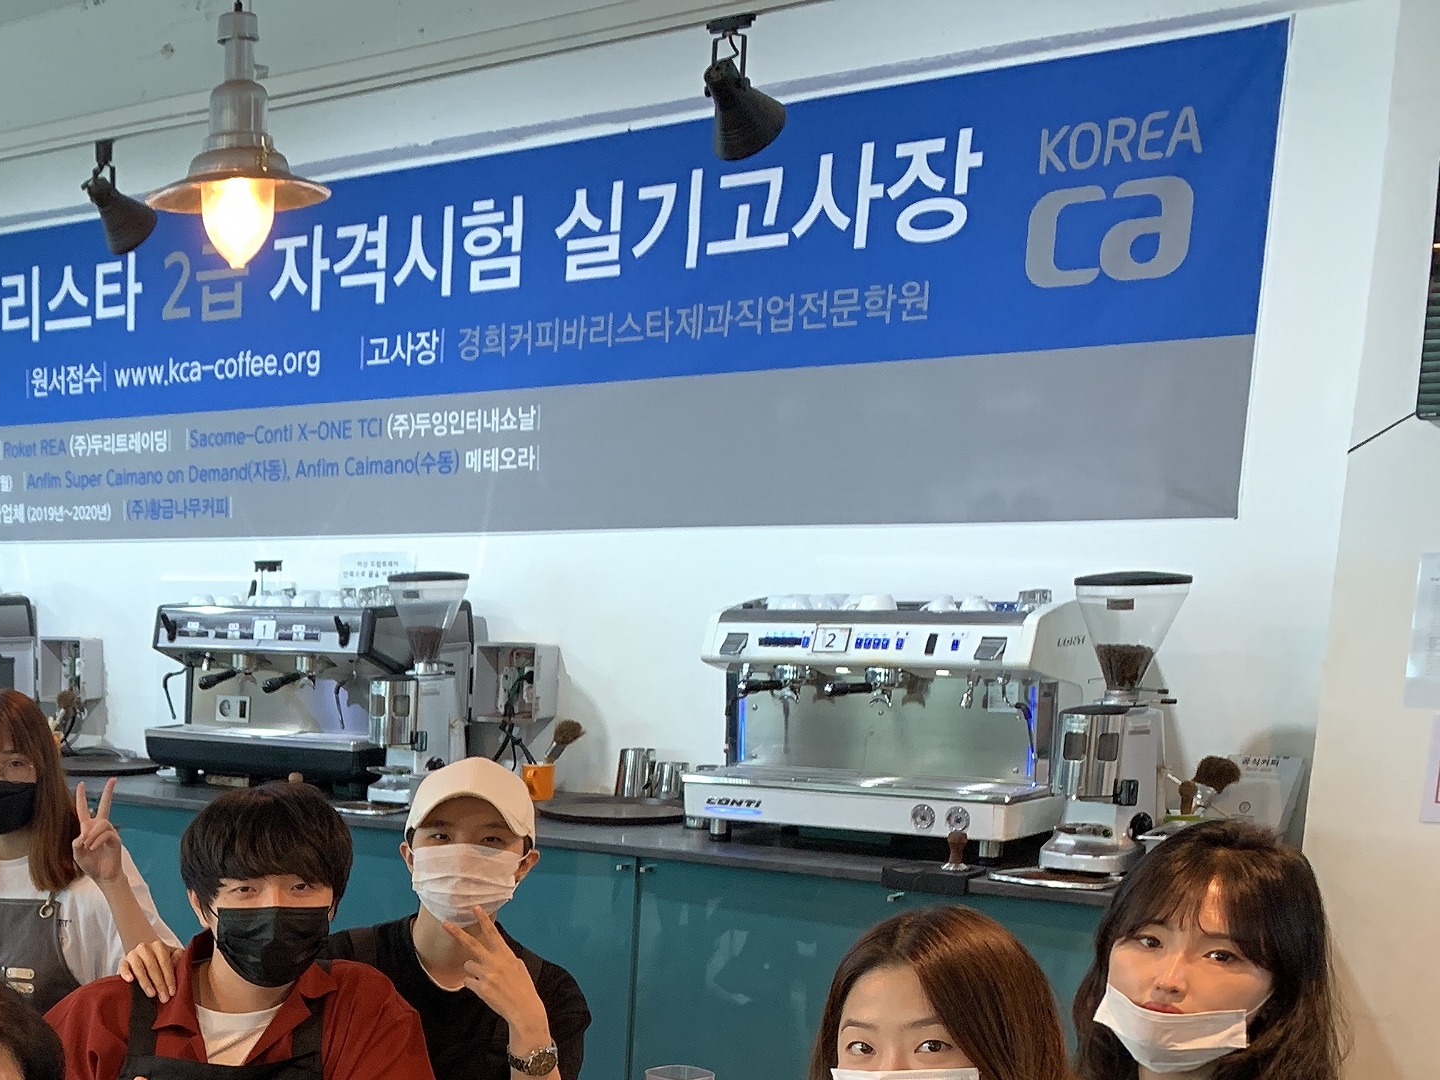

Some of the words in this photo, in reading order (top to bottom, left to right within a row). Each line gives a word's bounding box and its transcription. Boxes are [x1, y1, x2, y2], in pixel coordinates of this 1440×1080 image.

[1040, 106, 1202, 175] KOREA
[270, 196, 524, 311] 자격시험
[555, 128, 984, 283] 실기고사장
[1025, 176, 1195, 289] ca
[31, 362, 102, 398] 원서접수
[114, 349, 321, 388] www.kca-coffee.org
[366, 329, 439, 367] 고사장
[458, 279, 930, 362] 경희커피바리스타제과직업전문학원
[69, 430, 167, 458] (주)두리트레이딩
[190, 423, 293, 448] Sacome-Conti
[298, 419, 352, 442] X-ONE
[358, 418, 382, 439] TCI
[387, 404, 536, 440] (주)두잉인터내쇼날
[65, 470, 103, 490] Super
[167, 469, 184, 483] on
[465, 445, 536, 473] 메테오라
[825, 633, 836, 648] 2
[706, 797, 762, 808] CONTI
